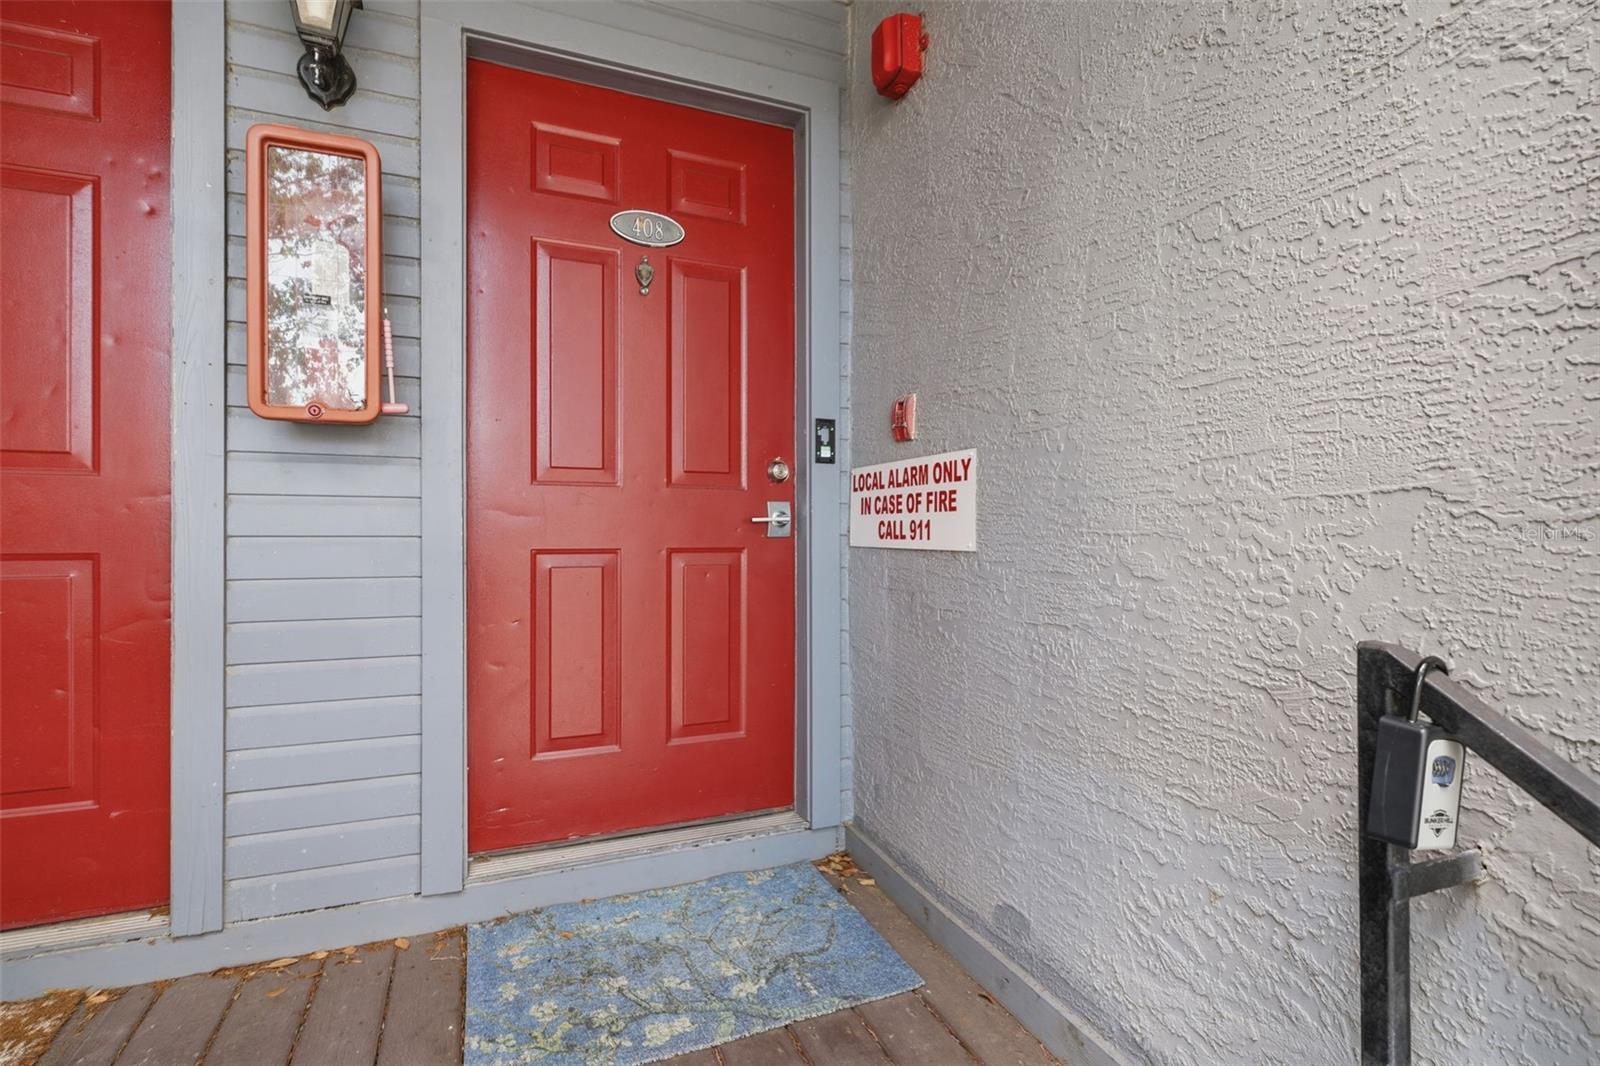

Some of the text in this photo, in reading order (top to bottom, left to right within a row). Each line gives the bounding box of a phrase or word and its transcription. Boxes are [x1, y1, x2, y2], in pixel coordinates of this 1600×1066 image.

[632, 217, 664, 240] 408
[853, 458, 971, 492] LOCAL ALARM ONLY
[860, 490, 957, 515] IN CASE OF FIRE
[878, 519, 931, 541] CALL 911
